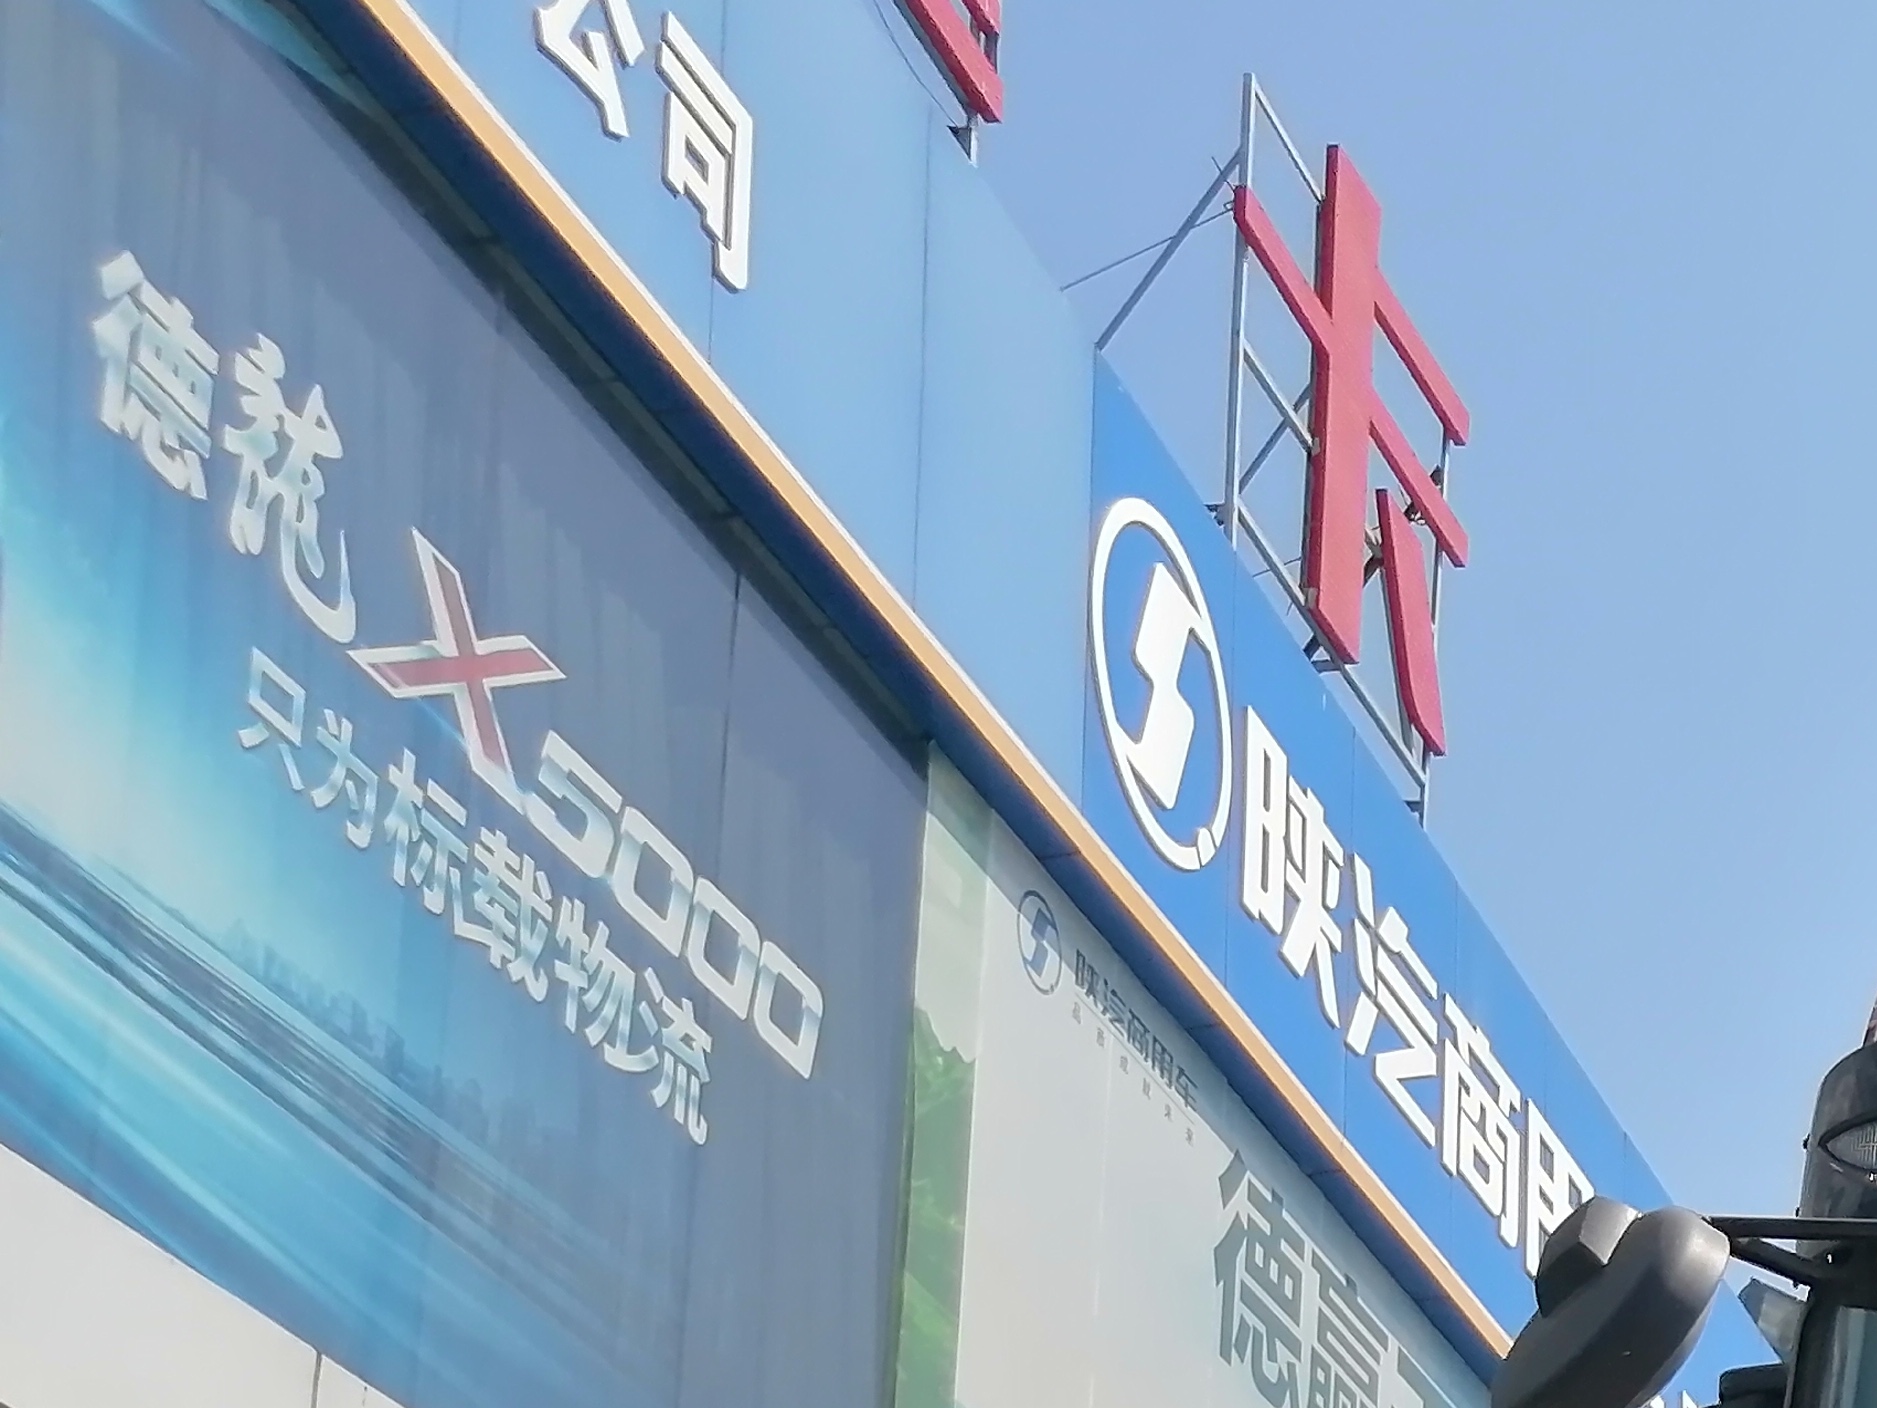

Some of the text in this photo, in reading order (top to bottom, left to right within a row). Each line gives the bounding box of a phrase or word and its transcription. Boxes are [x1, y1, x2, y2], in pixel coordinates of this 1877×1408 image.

[237, 647, 714, 1146] 只为标载物流
[1074, 948, 1199, 1112] 陕汽商用车
